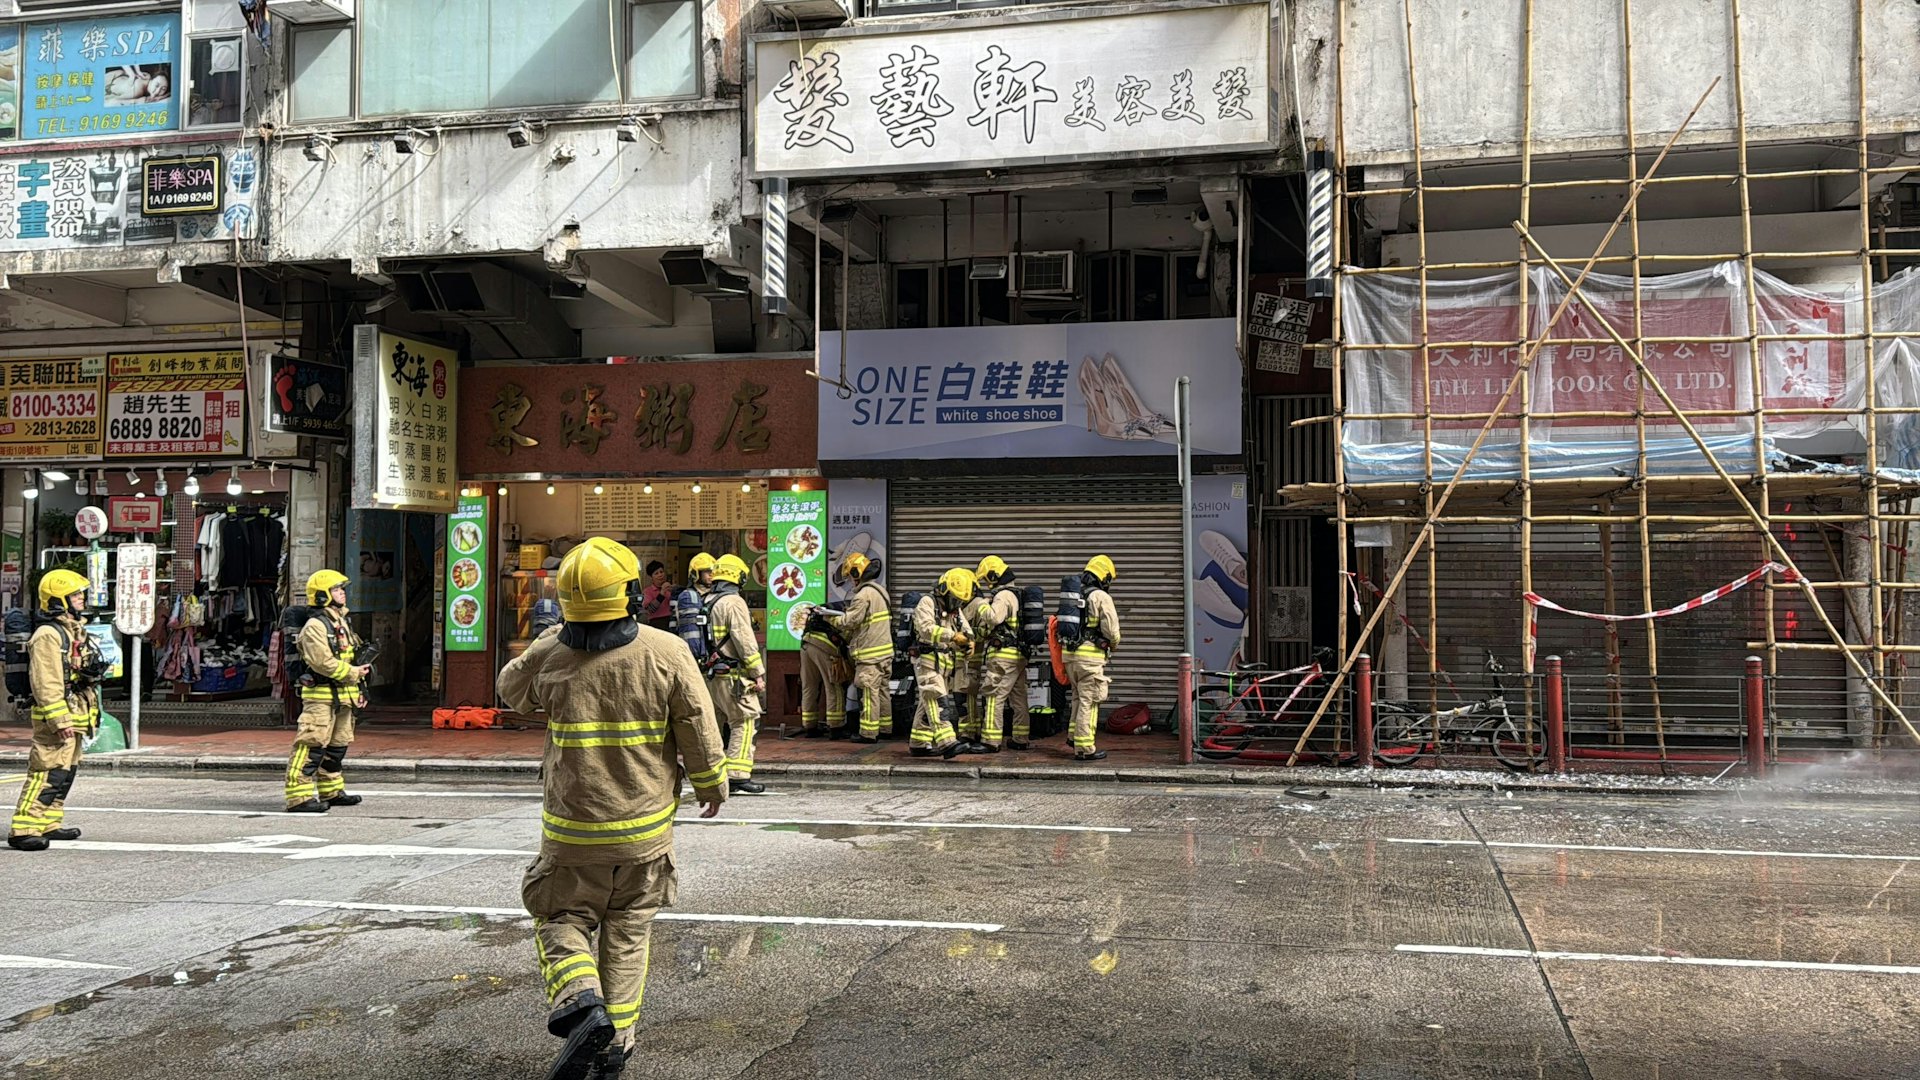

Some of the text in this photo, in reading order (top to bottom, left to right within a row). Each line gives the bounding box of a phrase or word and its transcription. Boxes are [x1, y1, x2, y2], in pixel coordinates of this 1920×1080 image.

[773, 44, 1255, 154] 髮藝軒 美容美髮
[79, 113, 121, 131] 9169
[125, 110, 169, 129] 9246
[190, 191, 213, 204] 9246
[1256, 294, 1310, 325] 通渠
[1250, 324, 1306, 344] 90817280
[148, 356, 244, 374] 創峰物業顧問
[390, 341, 430, 398] 東海
[434, 365, 446, 399] 粥店
[857, 365, 932, 395] ONE
[1483, 377, 1526, 396] LE
[1674, 372, 1733, 391] LTD.
[12, 392, 96, 418] 8100-3334
[122, 393, 192, 415] 趙先生
[225, 400, 241, 419] 租
[388, 396, 448, 423] 明火白粥
[852, 396, 928, 426] SIZE
[942, 406, 1058, 422] white shoe shoe
[32, 420, 97, 436] 2813-2628
[110, 416, 202, 440] 6889 8820
[486, 378, 772, 456] 東海粥店
[388, 418, 448, 443] 馳名生滾粥
[109, 441, 220, 454] 未得業主及租客同意
[387, 440, 447, 464] 即蒸腸粉
[387, 461, 447, 485] 生滾湯飯
[832, 504, 883, 514] MEET YOU
[1191, 501, 1231, 513] ASHION
